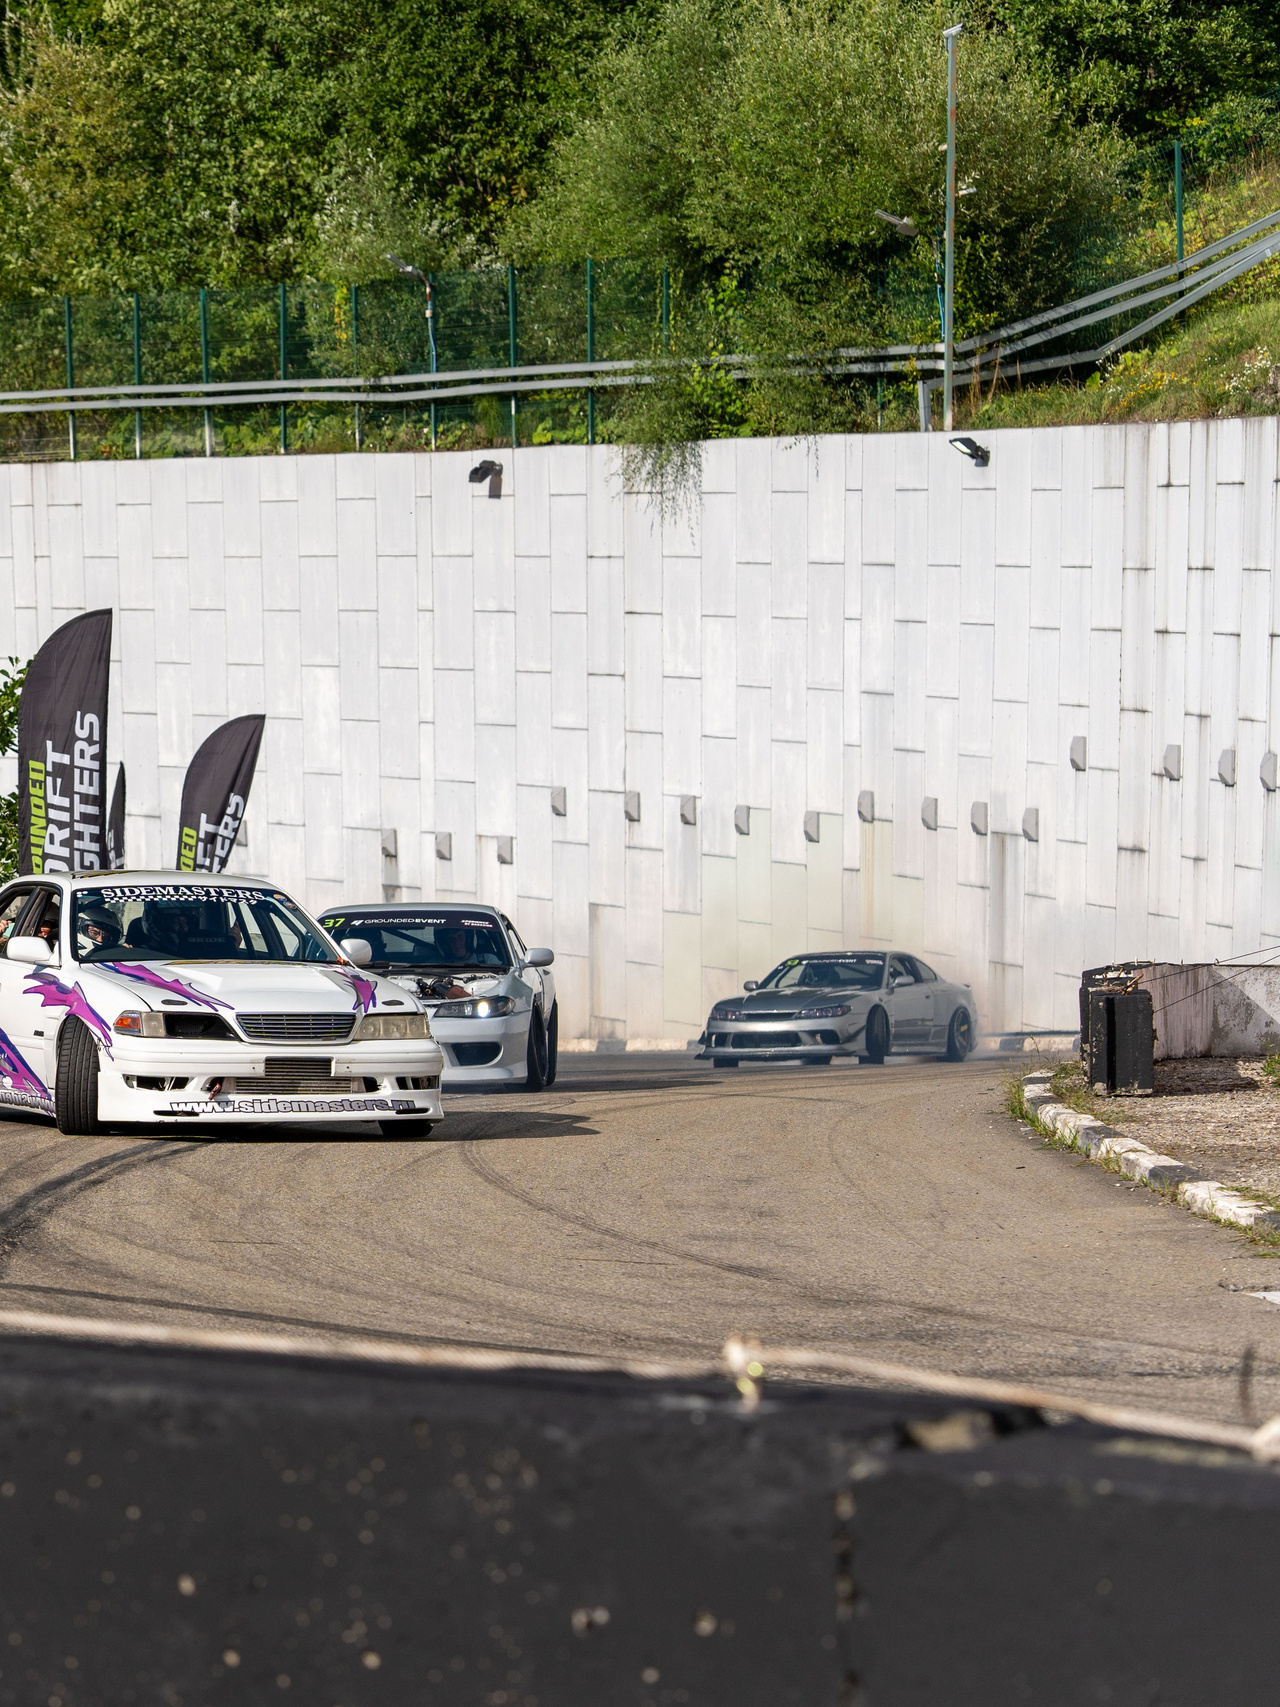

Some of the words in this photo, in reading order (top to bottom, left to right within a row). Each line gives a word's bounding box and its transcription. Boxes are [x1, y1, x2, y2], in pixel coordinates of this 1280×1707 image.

[74, 710, 100, 872] GHTERS
[28, 760, 47, 874] OUNDED
[100, 886, 266, 901] SIDEMASTERS
[323, 917, 346, 929] 37
[170, 1098, 416, 1114] www.sidemasters.ru
